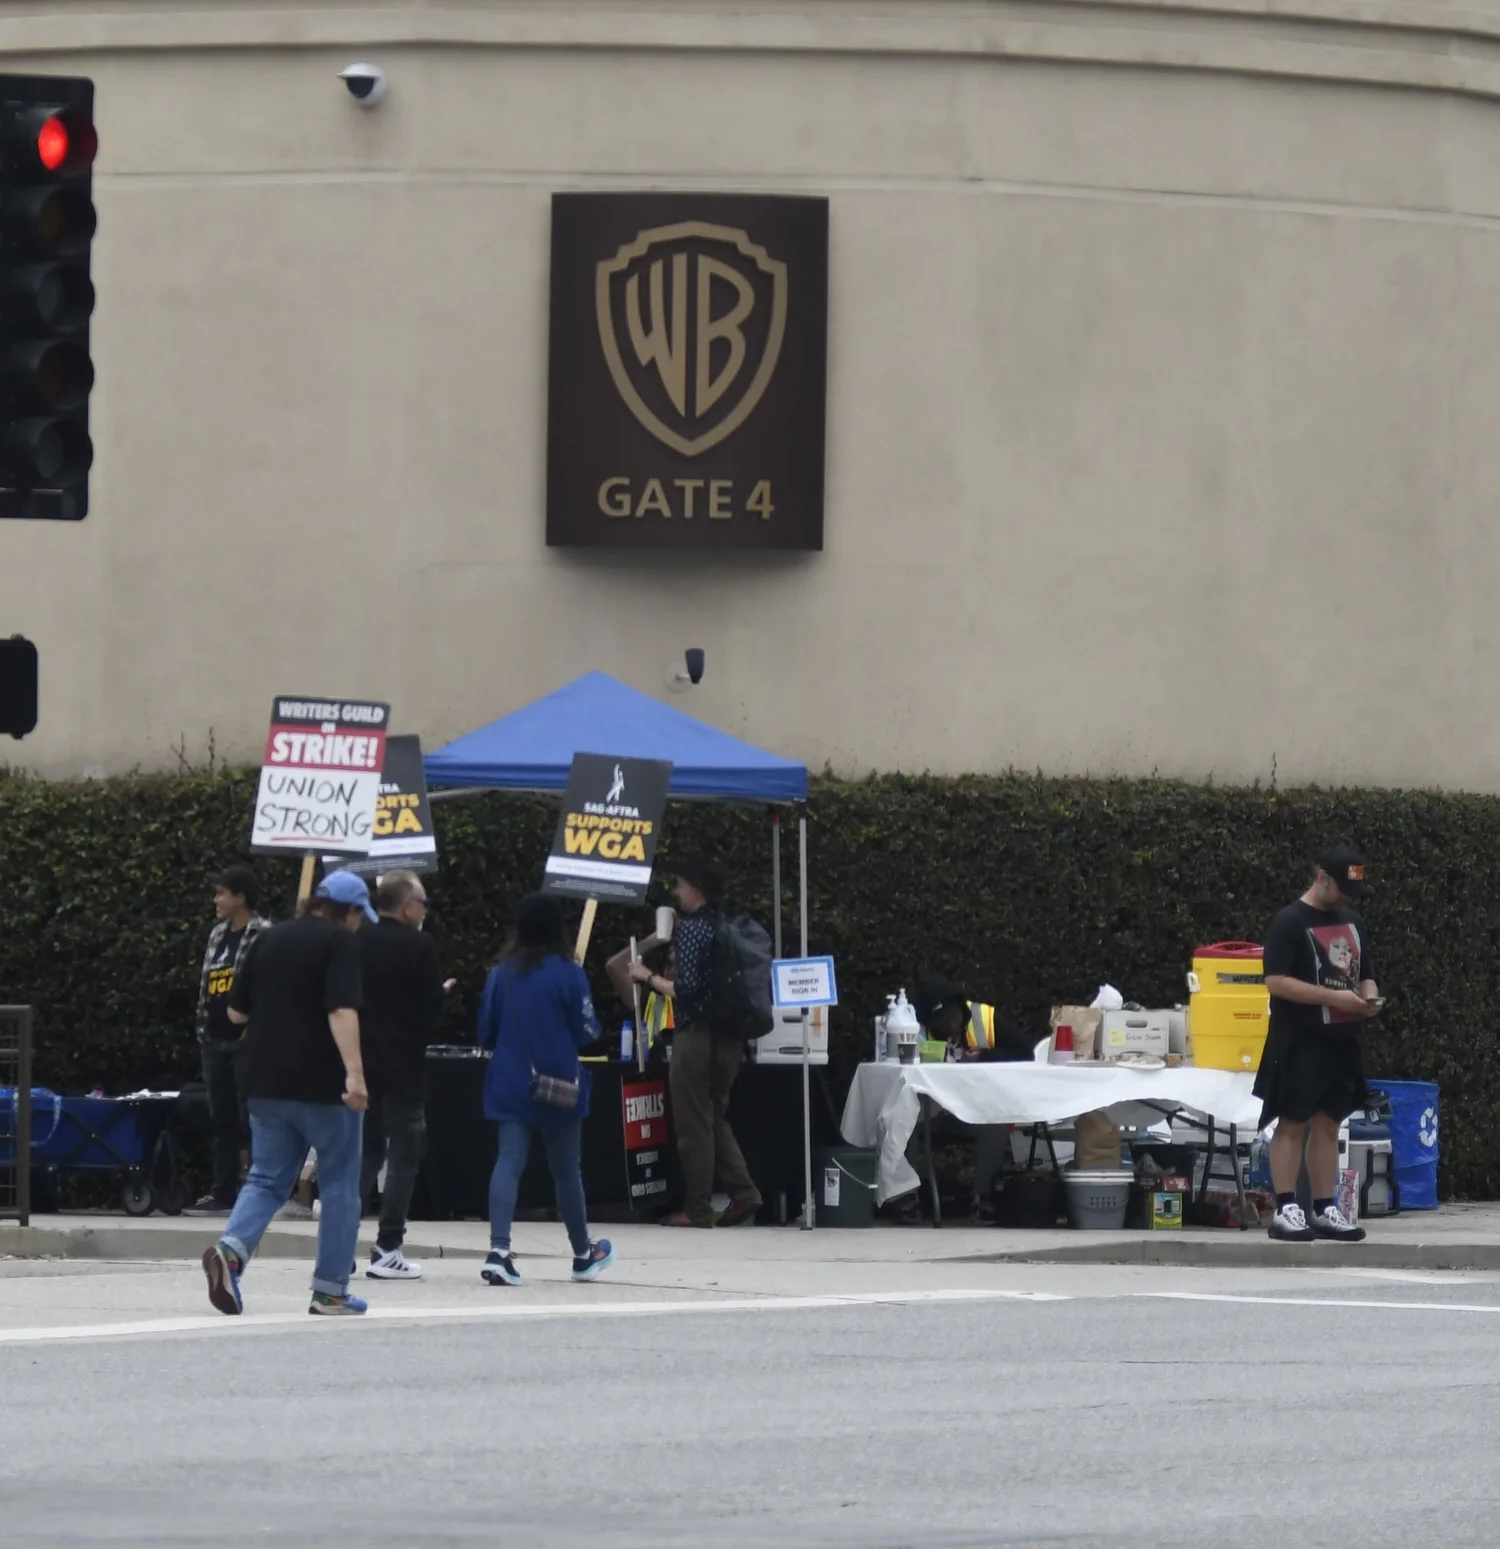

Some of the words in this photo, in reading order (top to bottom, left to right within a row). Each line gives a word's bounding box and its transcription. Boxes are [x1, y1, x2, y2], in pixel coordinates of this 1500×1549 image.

[626, 252, 755, 419] WB
[598, 477, 734, 519] GATE
[746, 479, 775, 520] 4
[279, 701, 340, 721] WRITERS
[342, 705, 385, 724] GUILD
[270, 732, 380, 769] STRIKE!
[267, 774, 359, 808] UNION
[256, 802, 373, 838] STRONG
[373, 807, 424, 836] GA
[565, 812, 653, 835] SUPPORTS
[563, 826, 646, 862] WGA
[625, 1093, 665, 1124] STRIKE!
